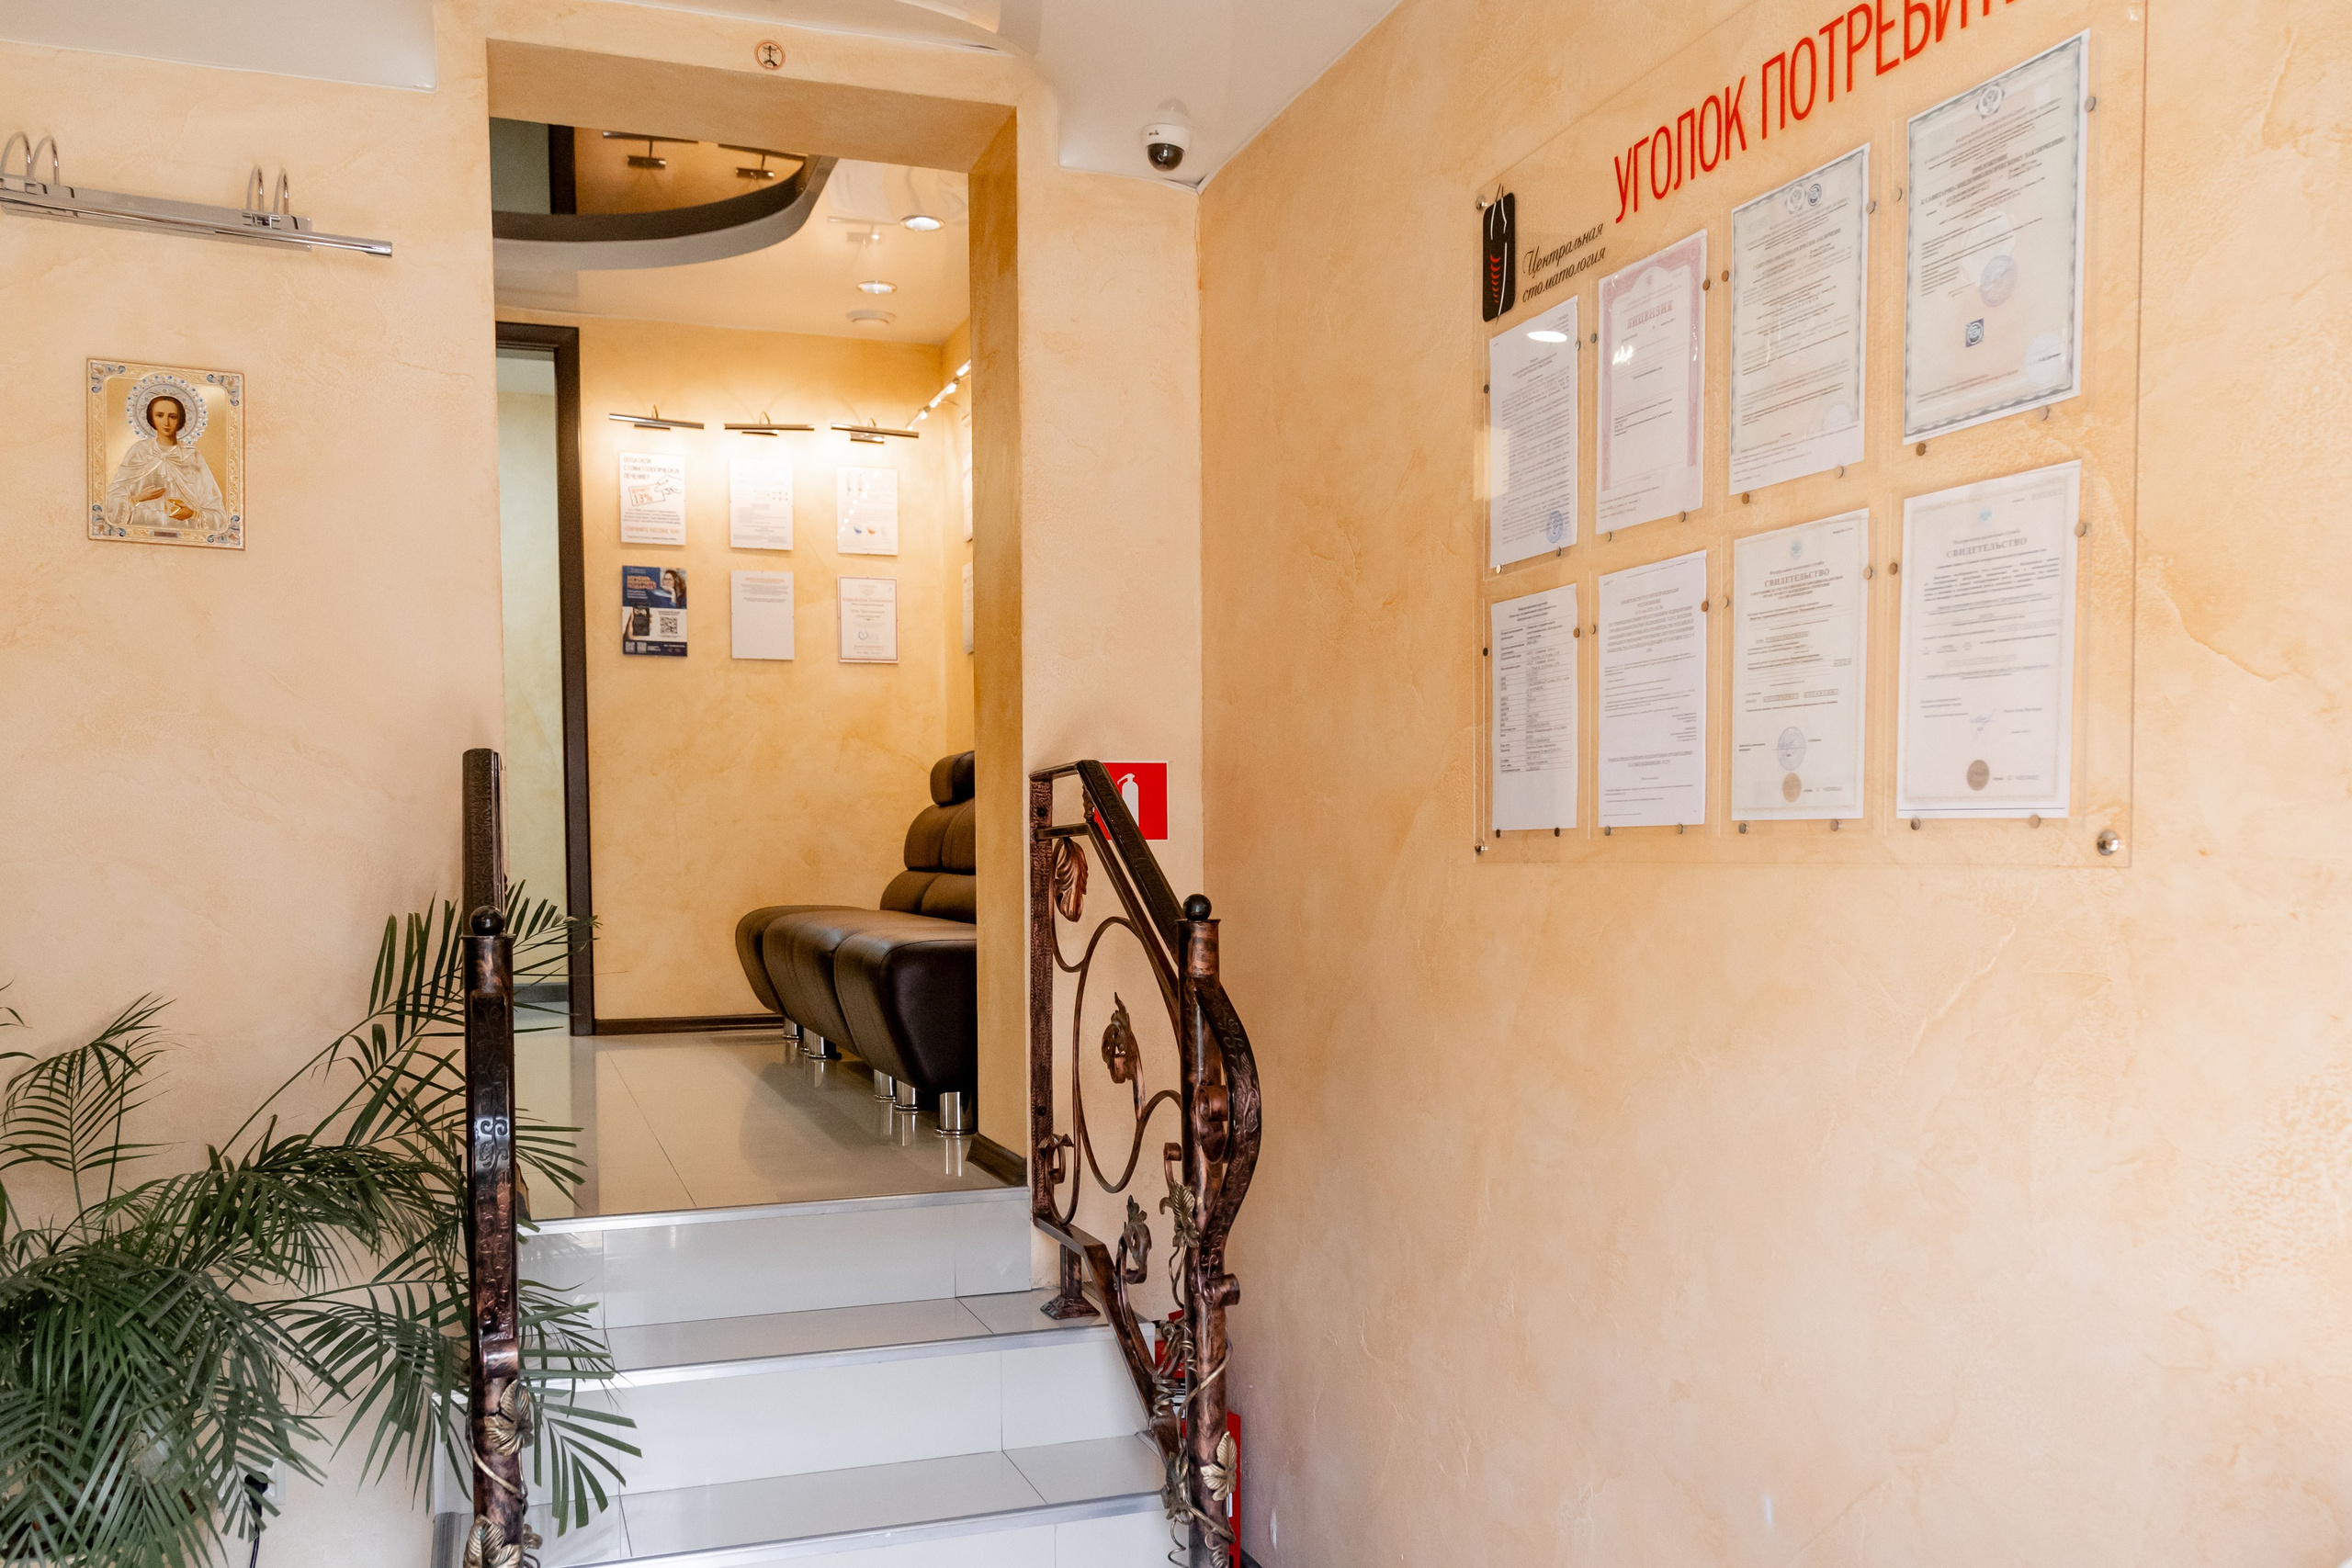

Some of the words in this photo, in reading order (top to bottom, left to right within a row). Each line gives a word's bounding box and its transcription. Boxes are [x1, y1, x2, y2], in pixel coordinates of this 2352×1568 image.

[1614, 74, 1747, 224] УГОЛОК
[1761, 0, 2018, 141] ПОТРЕБ
[1522, 222, 1603, 279] Центральная
[1522, 247, 1606, 303] стоматология
[1626, 299, 1674, 331] ЛИЦЕНЗИЯ
[634, 493, 653, 504] 13%
[1946, 537, 2028, 558] СВИДЕТЕЛЬСТВО
[1765, 568, 1830, 588] СВИДЕТЕЛЬСТВО
